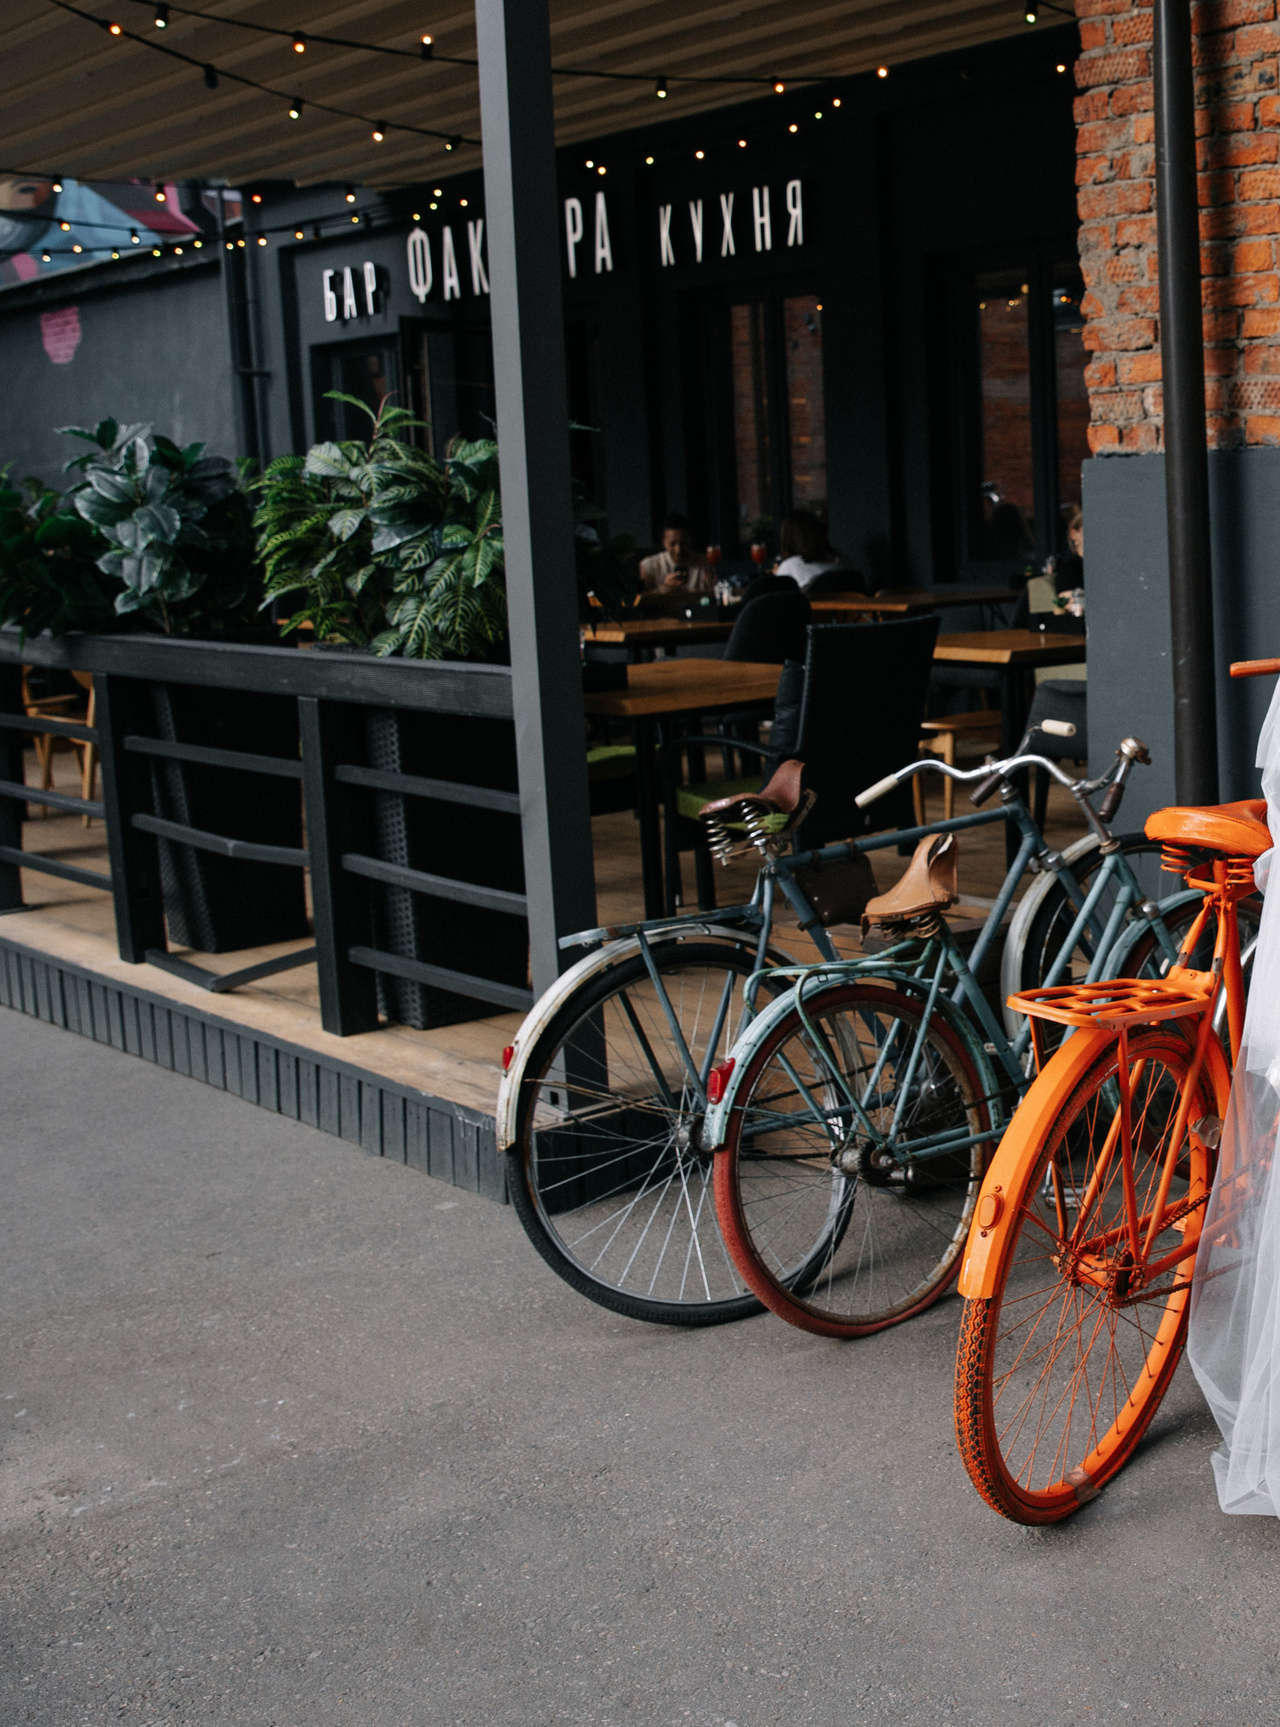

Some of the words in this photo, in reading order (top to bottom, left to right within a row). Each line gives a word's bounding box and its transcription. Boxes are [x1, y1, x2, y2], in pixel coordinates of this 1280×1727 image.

[323, 260, 377, 322] БАР
[407, 191, 613, 304] ФАКРА
[659, 179, 804, 267] КУХНЯ
